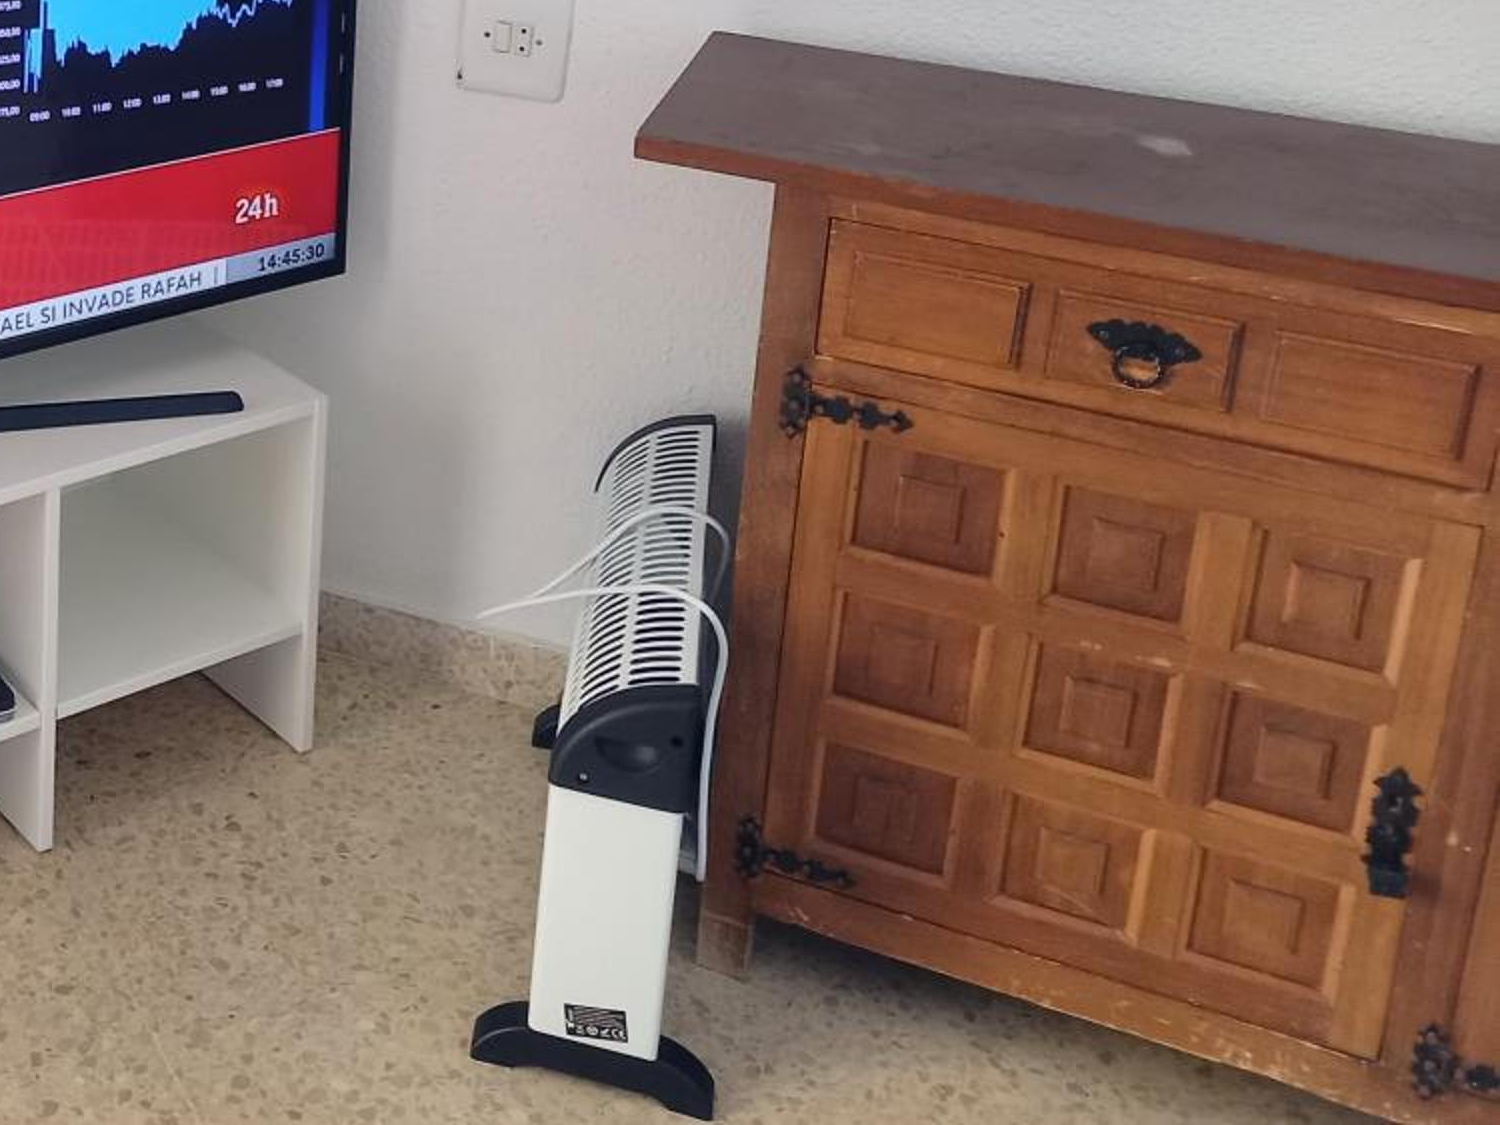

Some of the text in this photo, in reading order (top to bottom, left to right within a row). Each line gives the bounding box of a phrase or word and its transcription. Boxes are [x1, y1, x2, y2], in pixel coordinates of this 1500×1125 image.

[234, 190, 279, 224] 24h
[258, 242, 325, 272] 14:45:30
[40, 306, 57, 325] SI
[63, 286, 135, 319] INVADE
[141, 270, 202, 300] RAFAH
